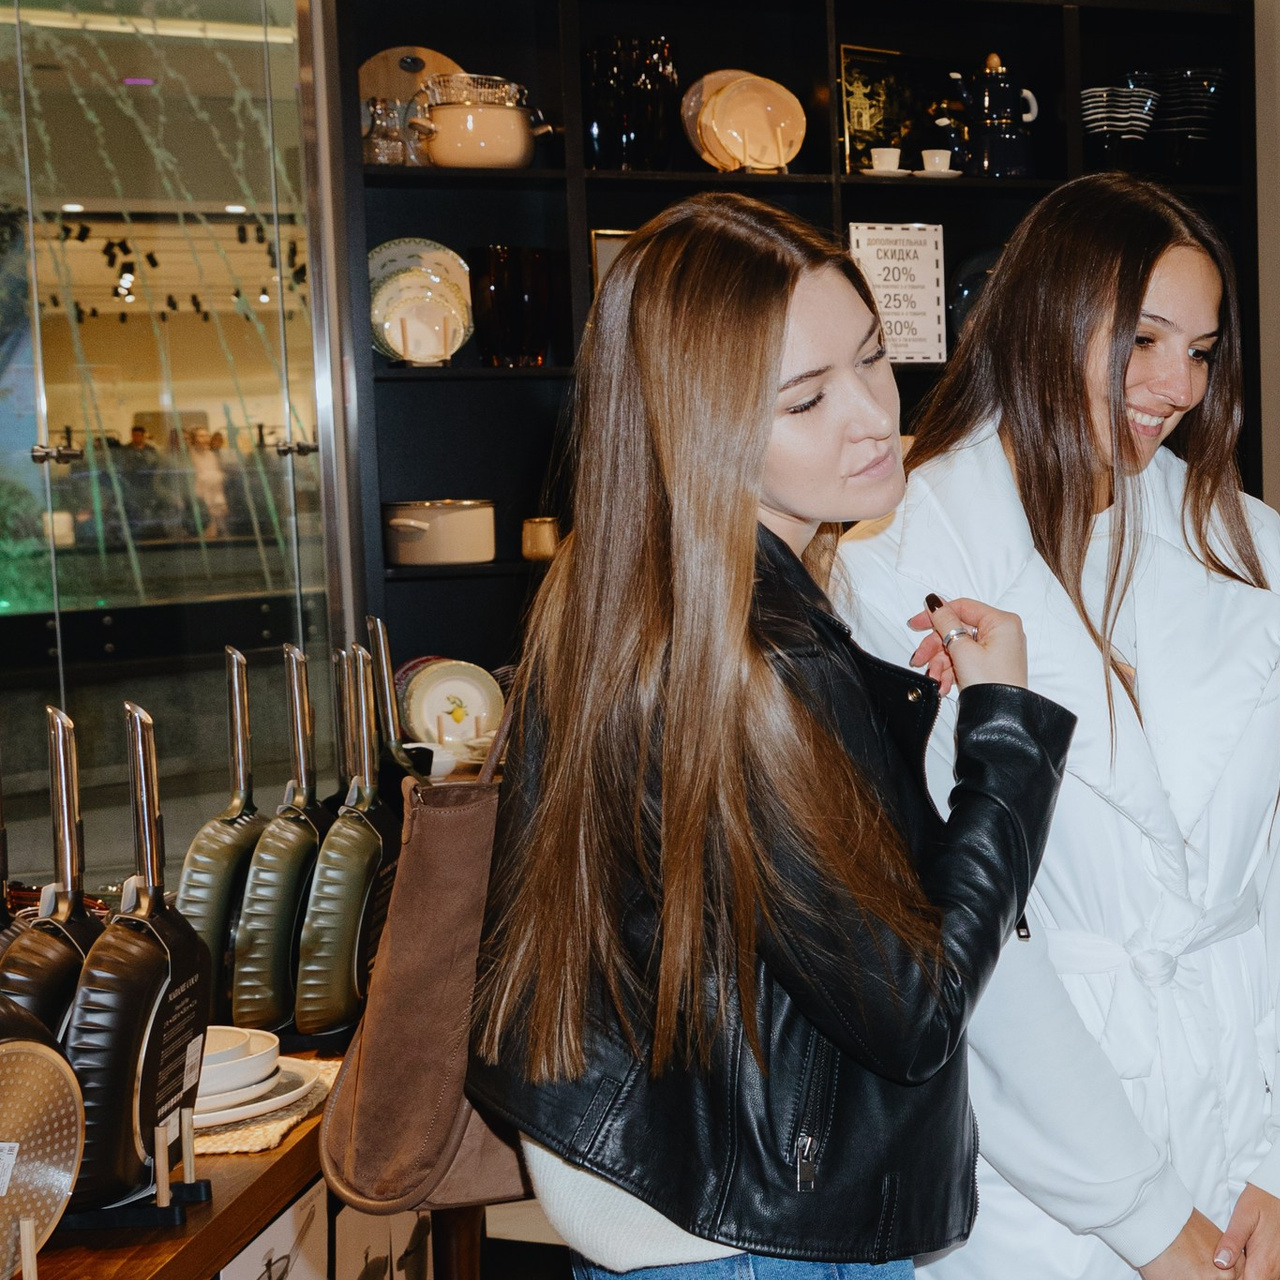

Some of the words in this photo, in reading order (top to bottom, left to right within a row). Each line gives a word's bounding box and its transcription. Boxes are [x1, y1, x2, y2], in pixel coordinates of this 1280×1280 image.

[866, 238, 927, 247] ДОПОЛНИТЕЛЬНАЯ
[876, 248, 920, 261] СКИДКА
[877, 266, 916, 282] -20%
[879, 293, 917, 309] -25%
